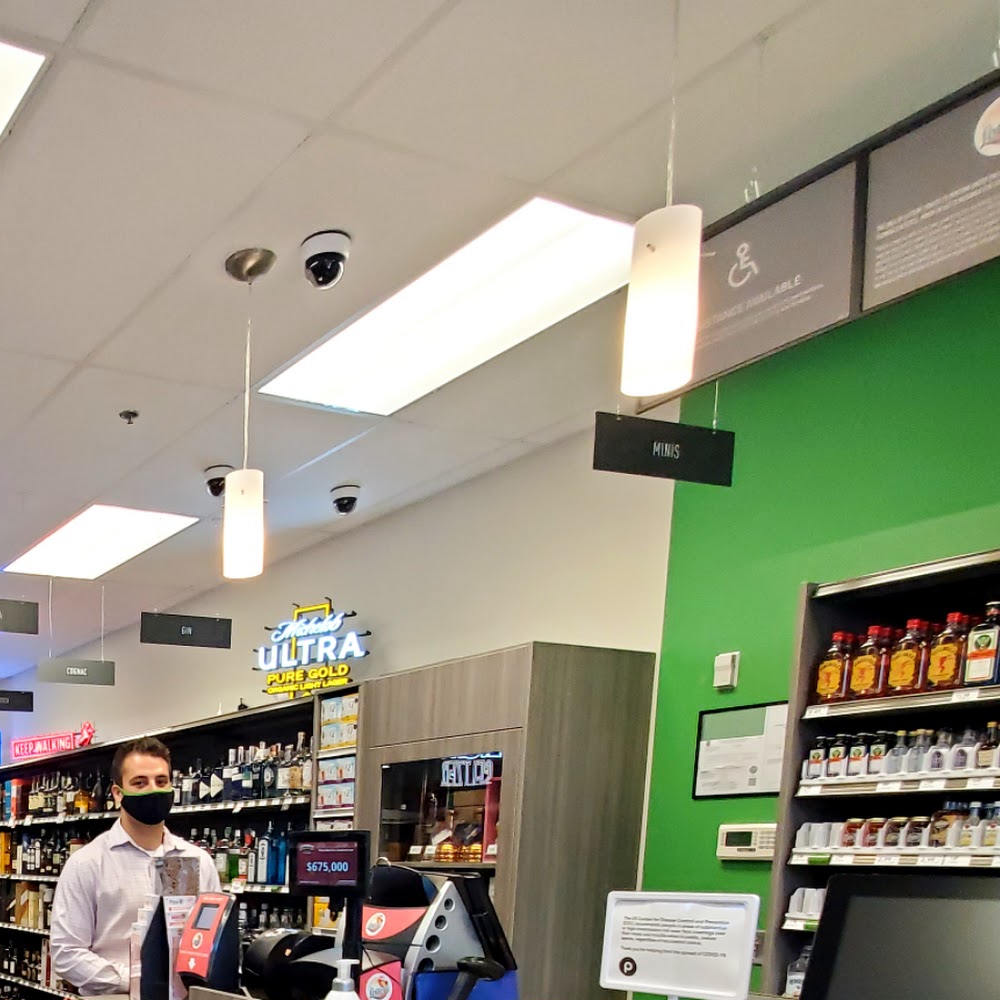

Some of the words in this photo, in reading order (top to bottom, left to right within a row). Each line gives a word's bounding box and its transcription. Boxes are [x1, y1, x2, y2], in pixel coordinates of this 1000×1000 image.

[653, 441, 680, 459] MINIS
[258, 631, 365, 671] ULTRA
[66, 667, 87, 676] COGNAC
[266, 670, 305, 685] PURE
[308, 664, 350, 679] GOLD
[15, 741, 34, 755] KEEP
[34, 736, 71, 754] WALKING
[306, 861, 349, 873] $675,000
